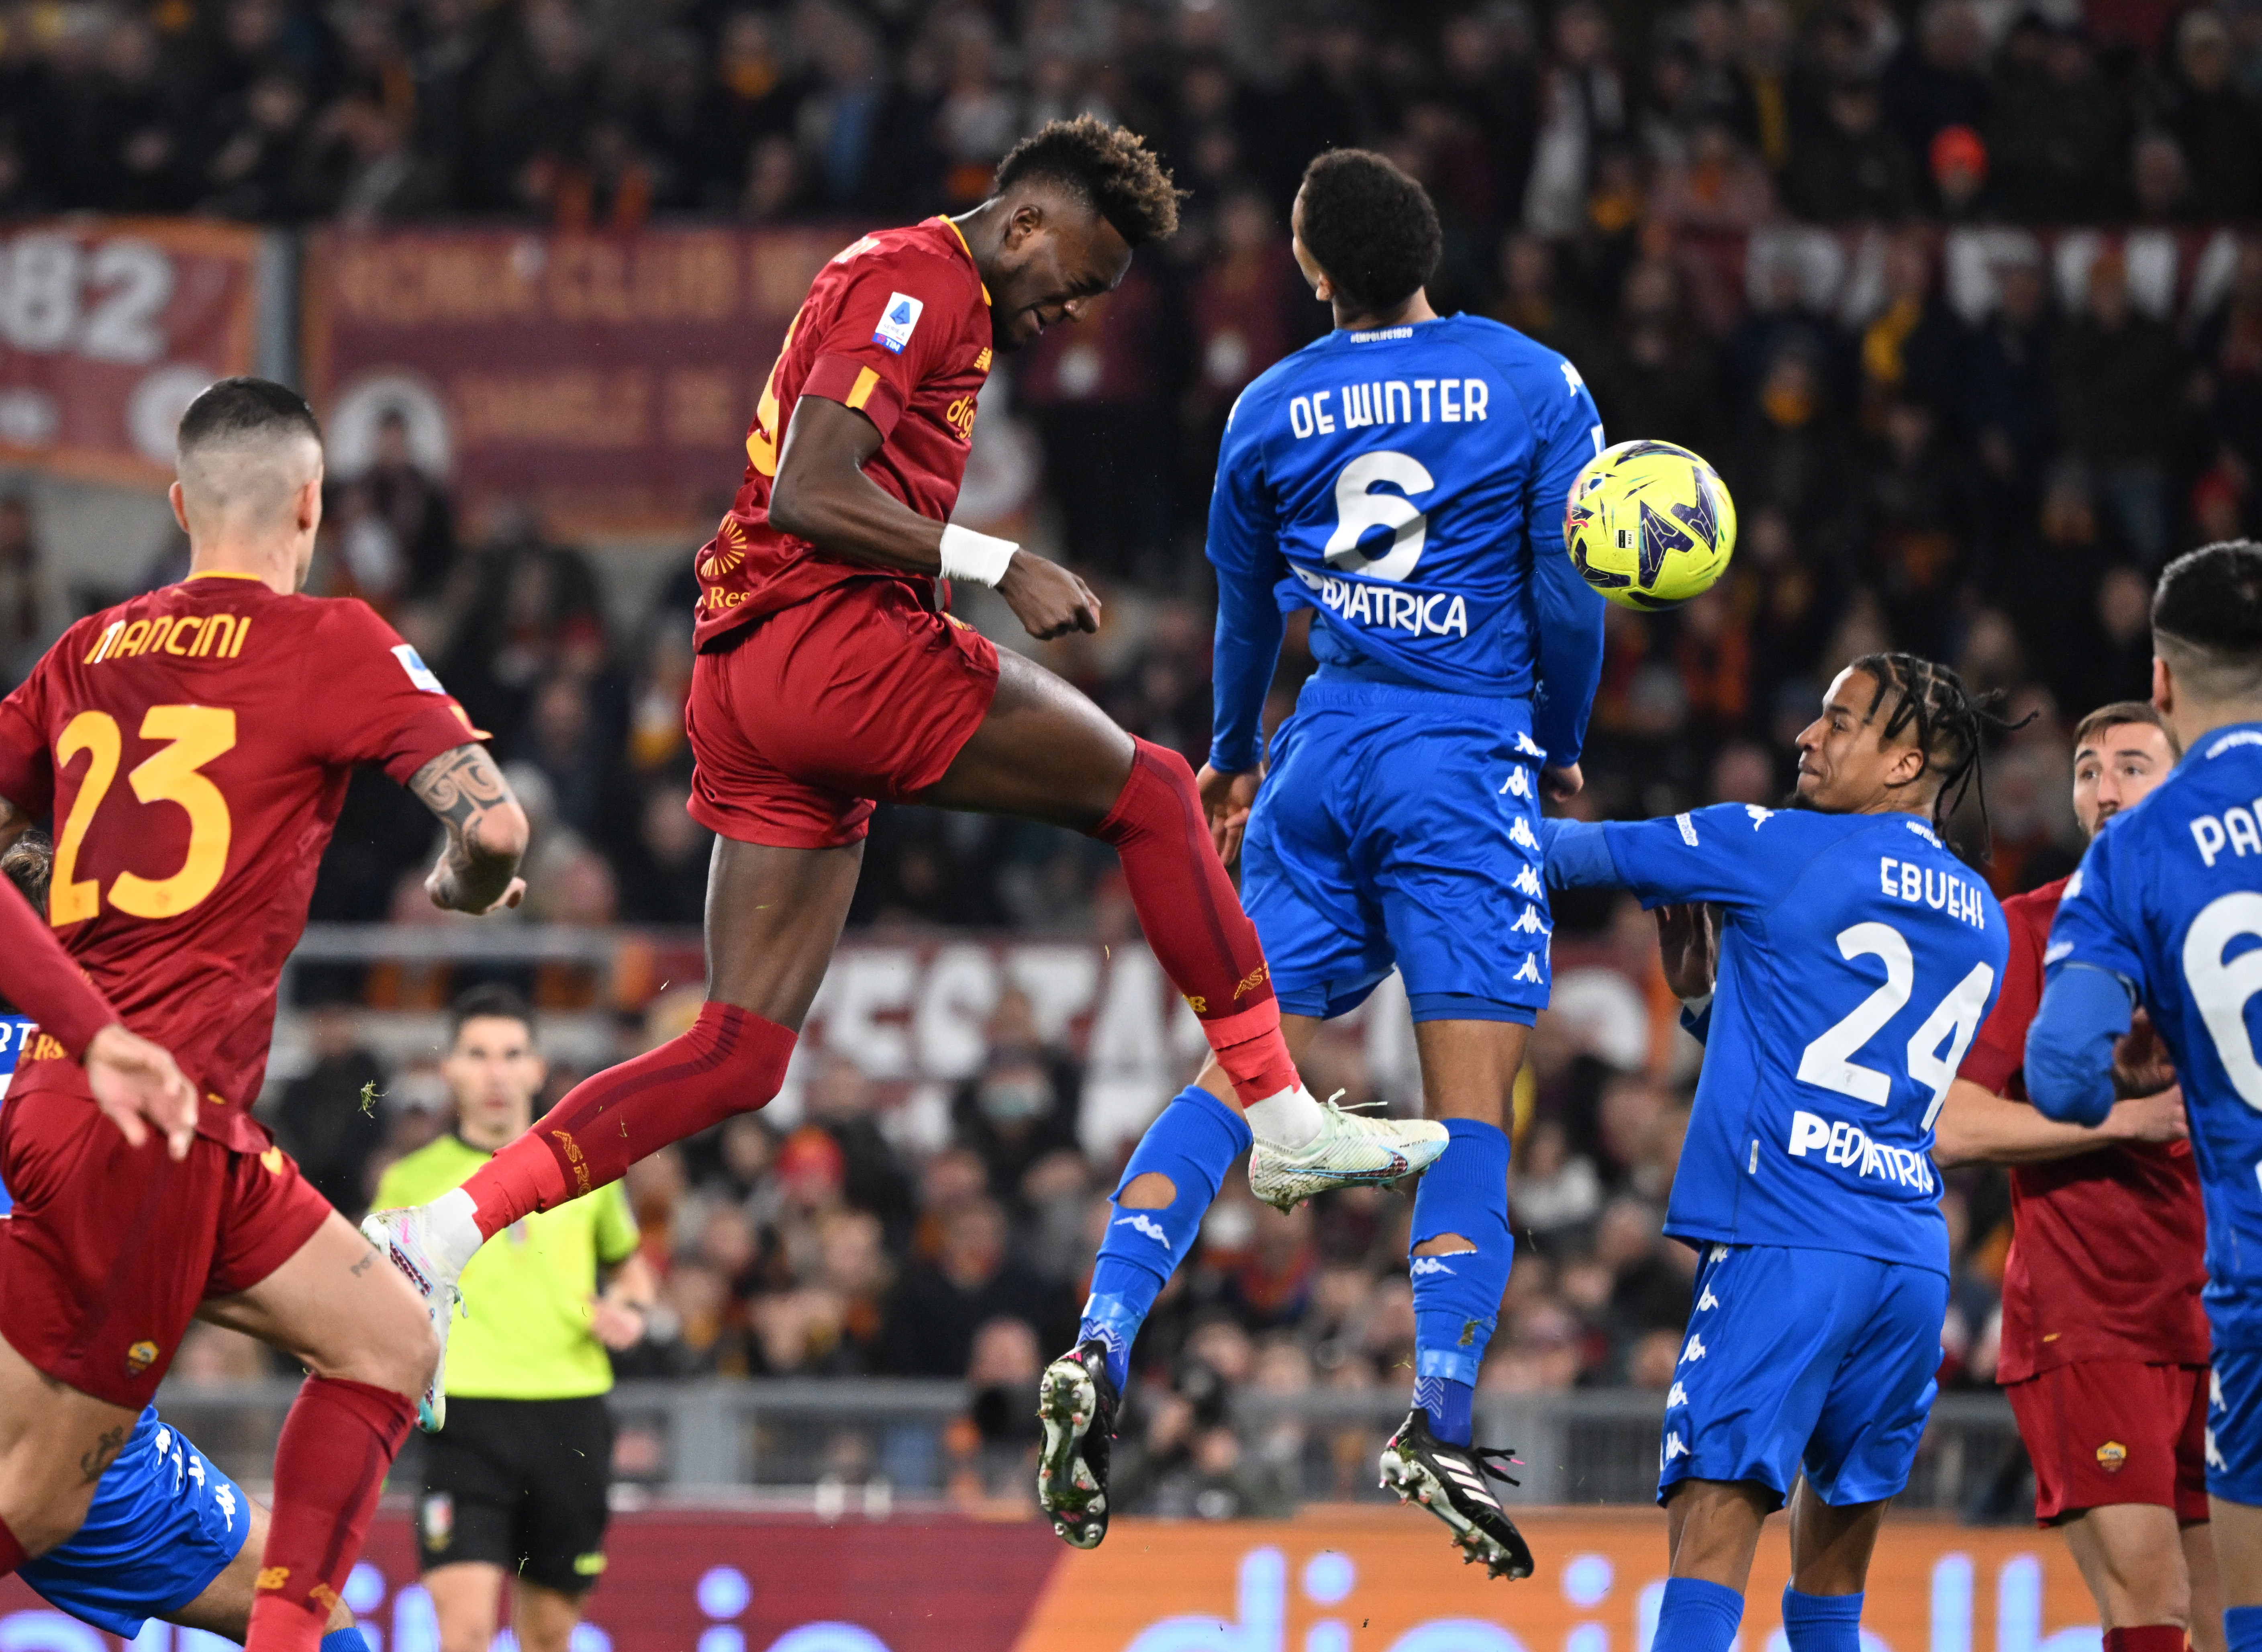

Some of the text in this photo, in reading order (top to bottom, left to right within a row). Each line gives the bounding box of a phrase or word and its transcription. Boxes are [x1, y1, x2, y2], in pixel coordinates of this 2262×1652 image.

[886, 337, 900, 352] TIM
[1289, 378, 1488, 439] DE WINTER
[1323, 450, 1434, 583] 6
[83, 613, 252, 664] MANCINI
[50, 704, 236, 927] 23
[1880, 856, 1984, 930] EBUEHI
[1796, 922, 1994, 1133] 24
